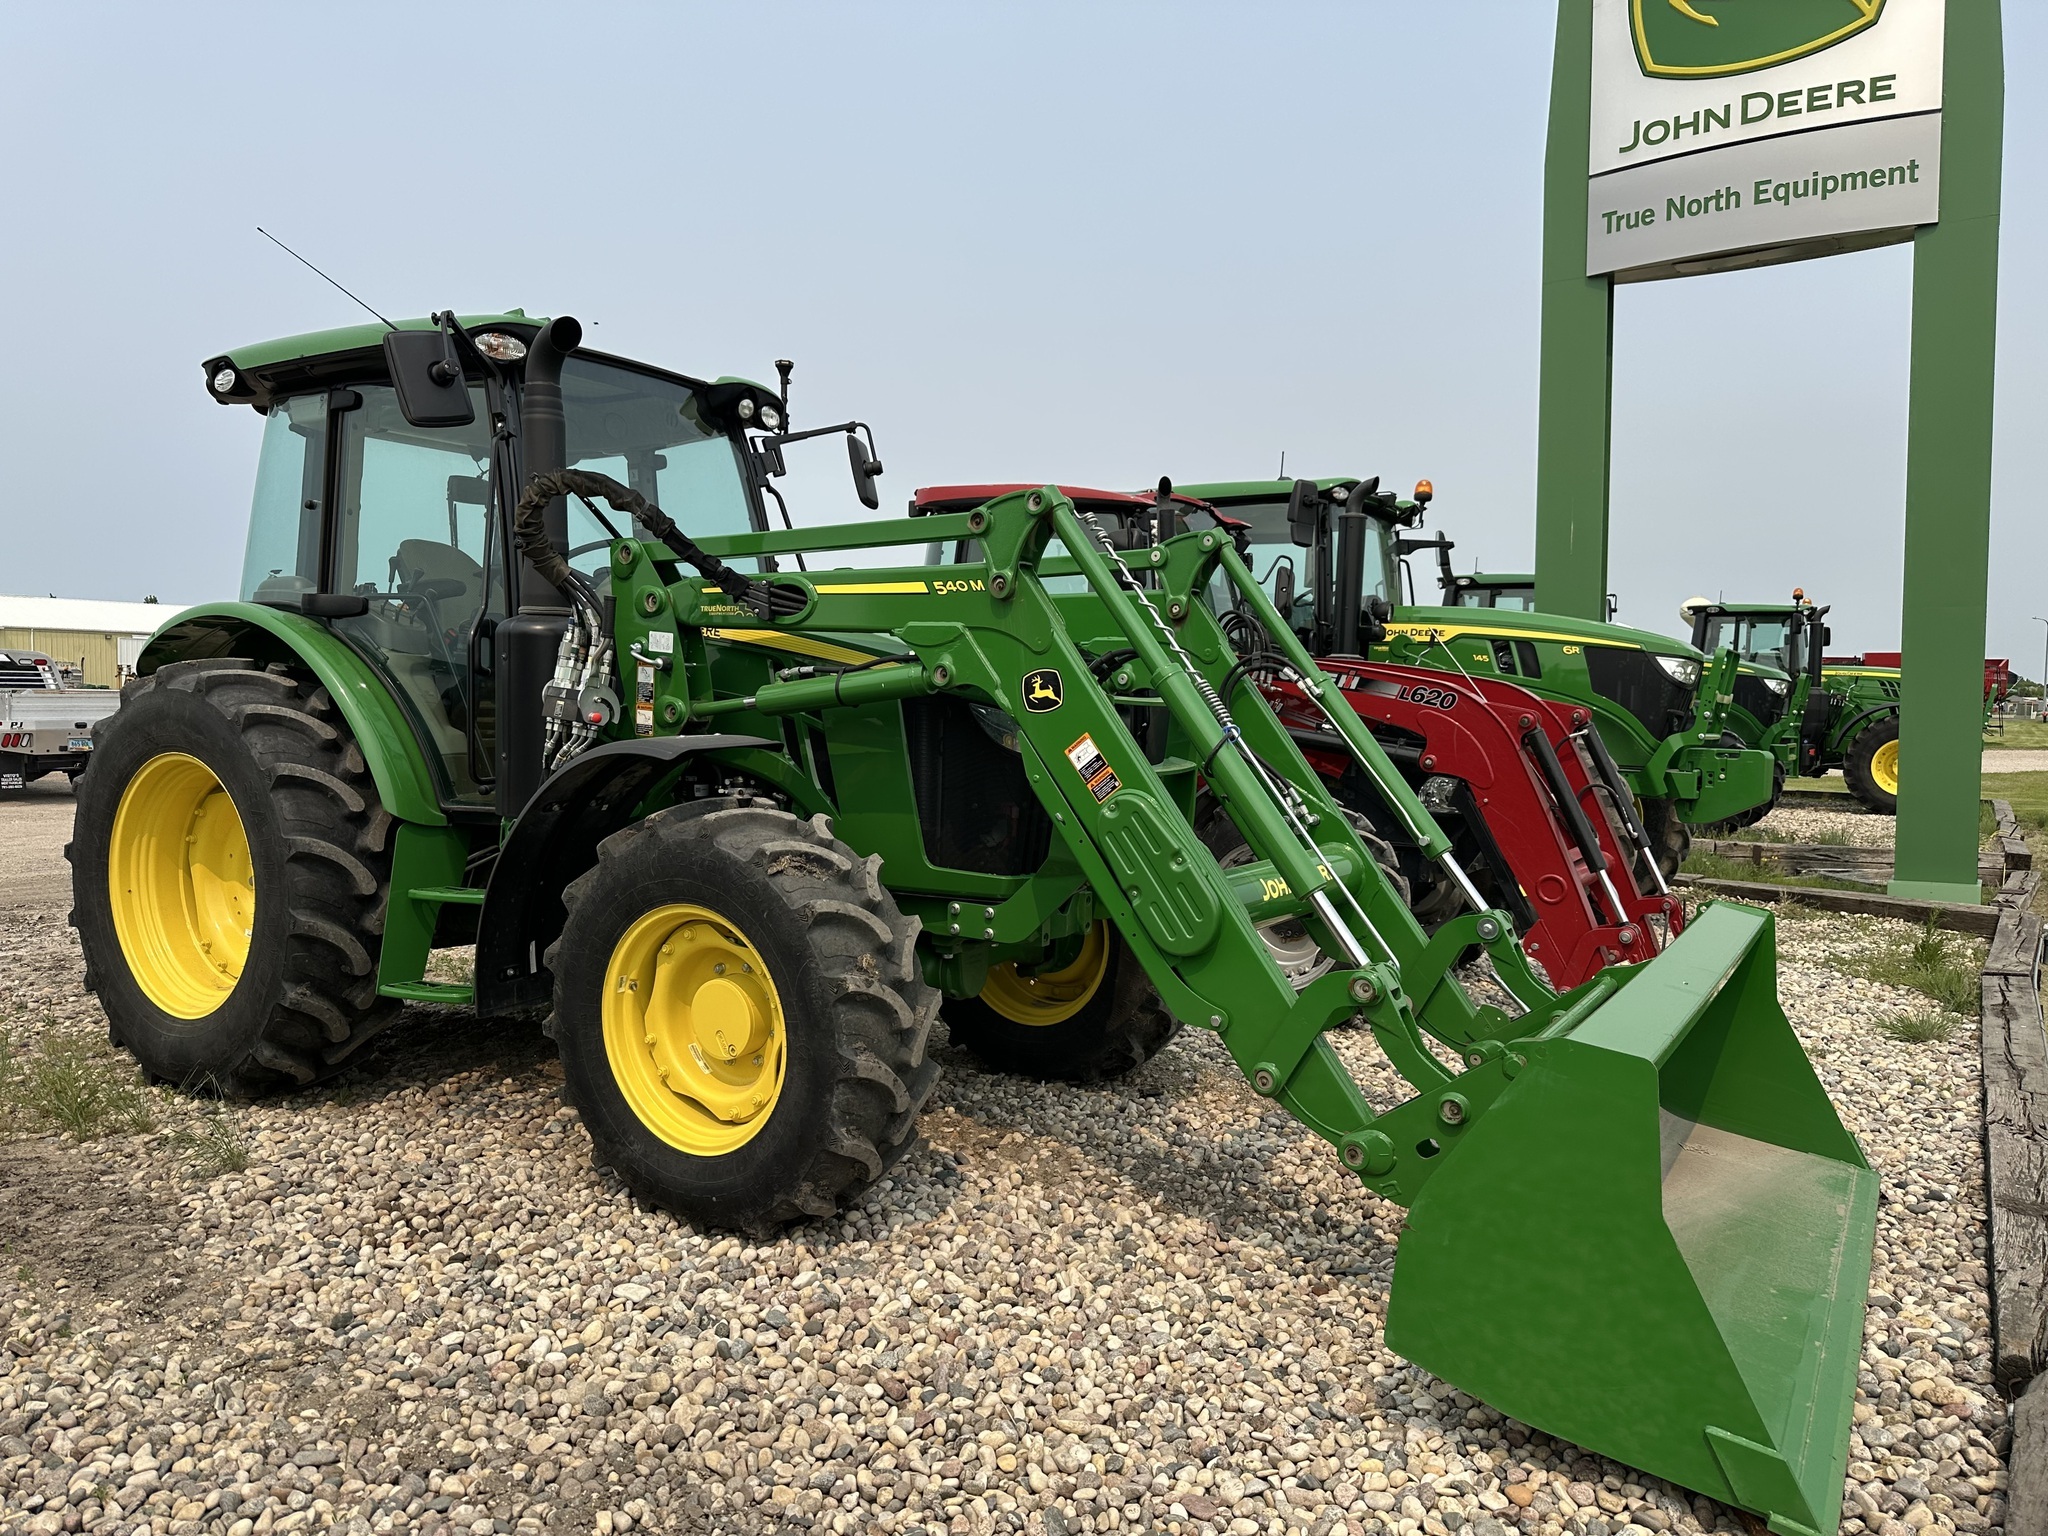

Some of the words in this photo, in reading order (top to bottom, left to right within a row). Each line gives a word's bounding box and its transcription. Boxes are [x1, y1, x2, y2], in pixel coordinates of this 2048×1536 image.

[1619, 104, 1731, 154] JOHN
[1741, 74, 1896, 126] DEERE
[1602, 209, 1656, 235] True
[1666, 186, 1741, 222] North
[1753, 159, 1920, 207] Equipment
[932, 580, 969, 595] 540
[969, 579, 986, 592] M
[1386, 629, 1408, 638] OHN
[1473, 654, 1490, 662] 145
[1562, 645, 1580, 655] 6R
[1398, 685, 1458, 710] L620
[1260, 877, 1293, 902] JOH
